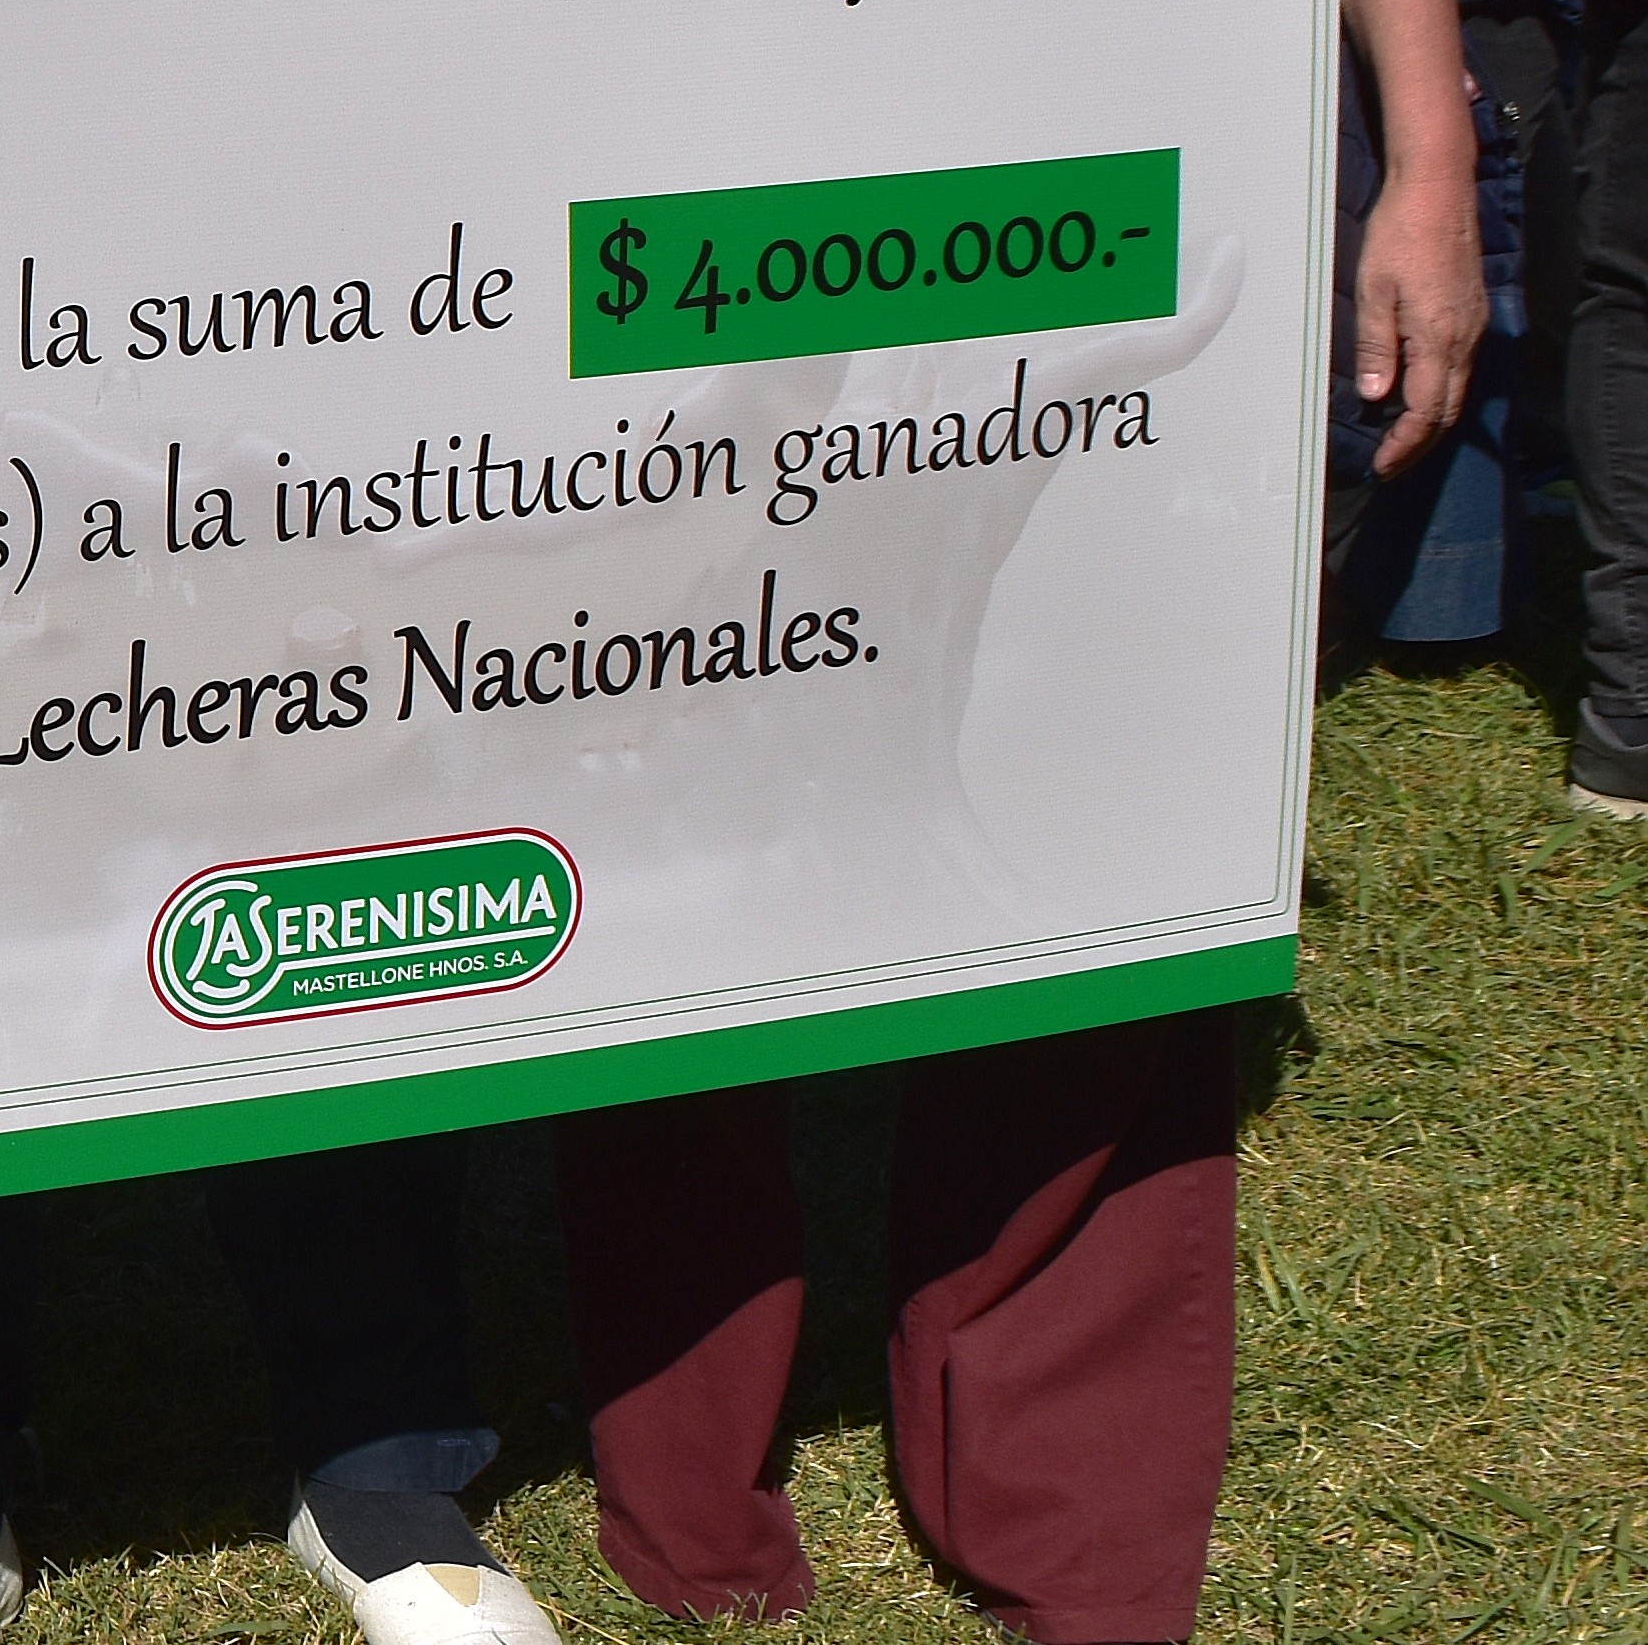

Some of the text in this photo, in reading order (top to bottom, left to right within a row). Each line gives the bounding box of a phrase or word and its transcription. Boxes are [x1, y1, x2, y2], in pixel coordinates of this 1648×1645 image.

[19, 256, 103, 371] la
[126, 267, 385, 360] suma
[409, 220, 515, 335] de
[595, 210, 1152, 335] $ 4.000.000.-
[80, 497, 137, 562] a
[165, 441, 246, 554] la
[273, 409, 747, 545] institución
[763, 356, 1161, 527] ganadora
[393, 568, 881, 723] Nacionales.
[291, 949, 528, 998] MASTELLONE HNOS. S.A.
